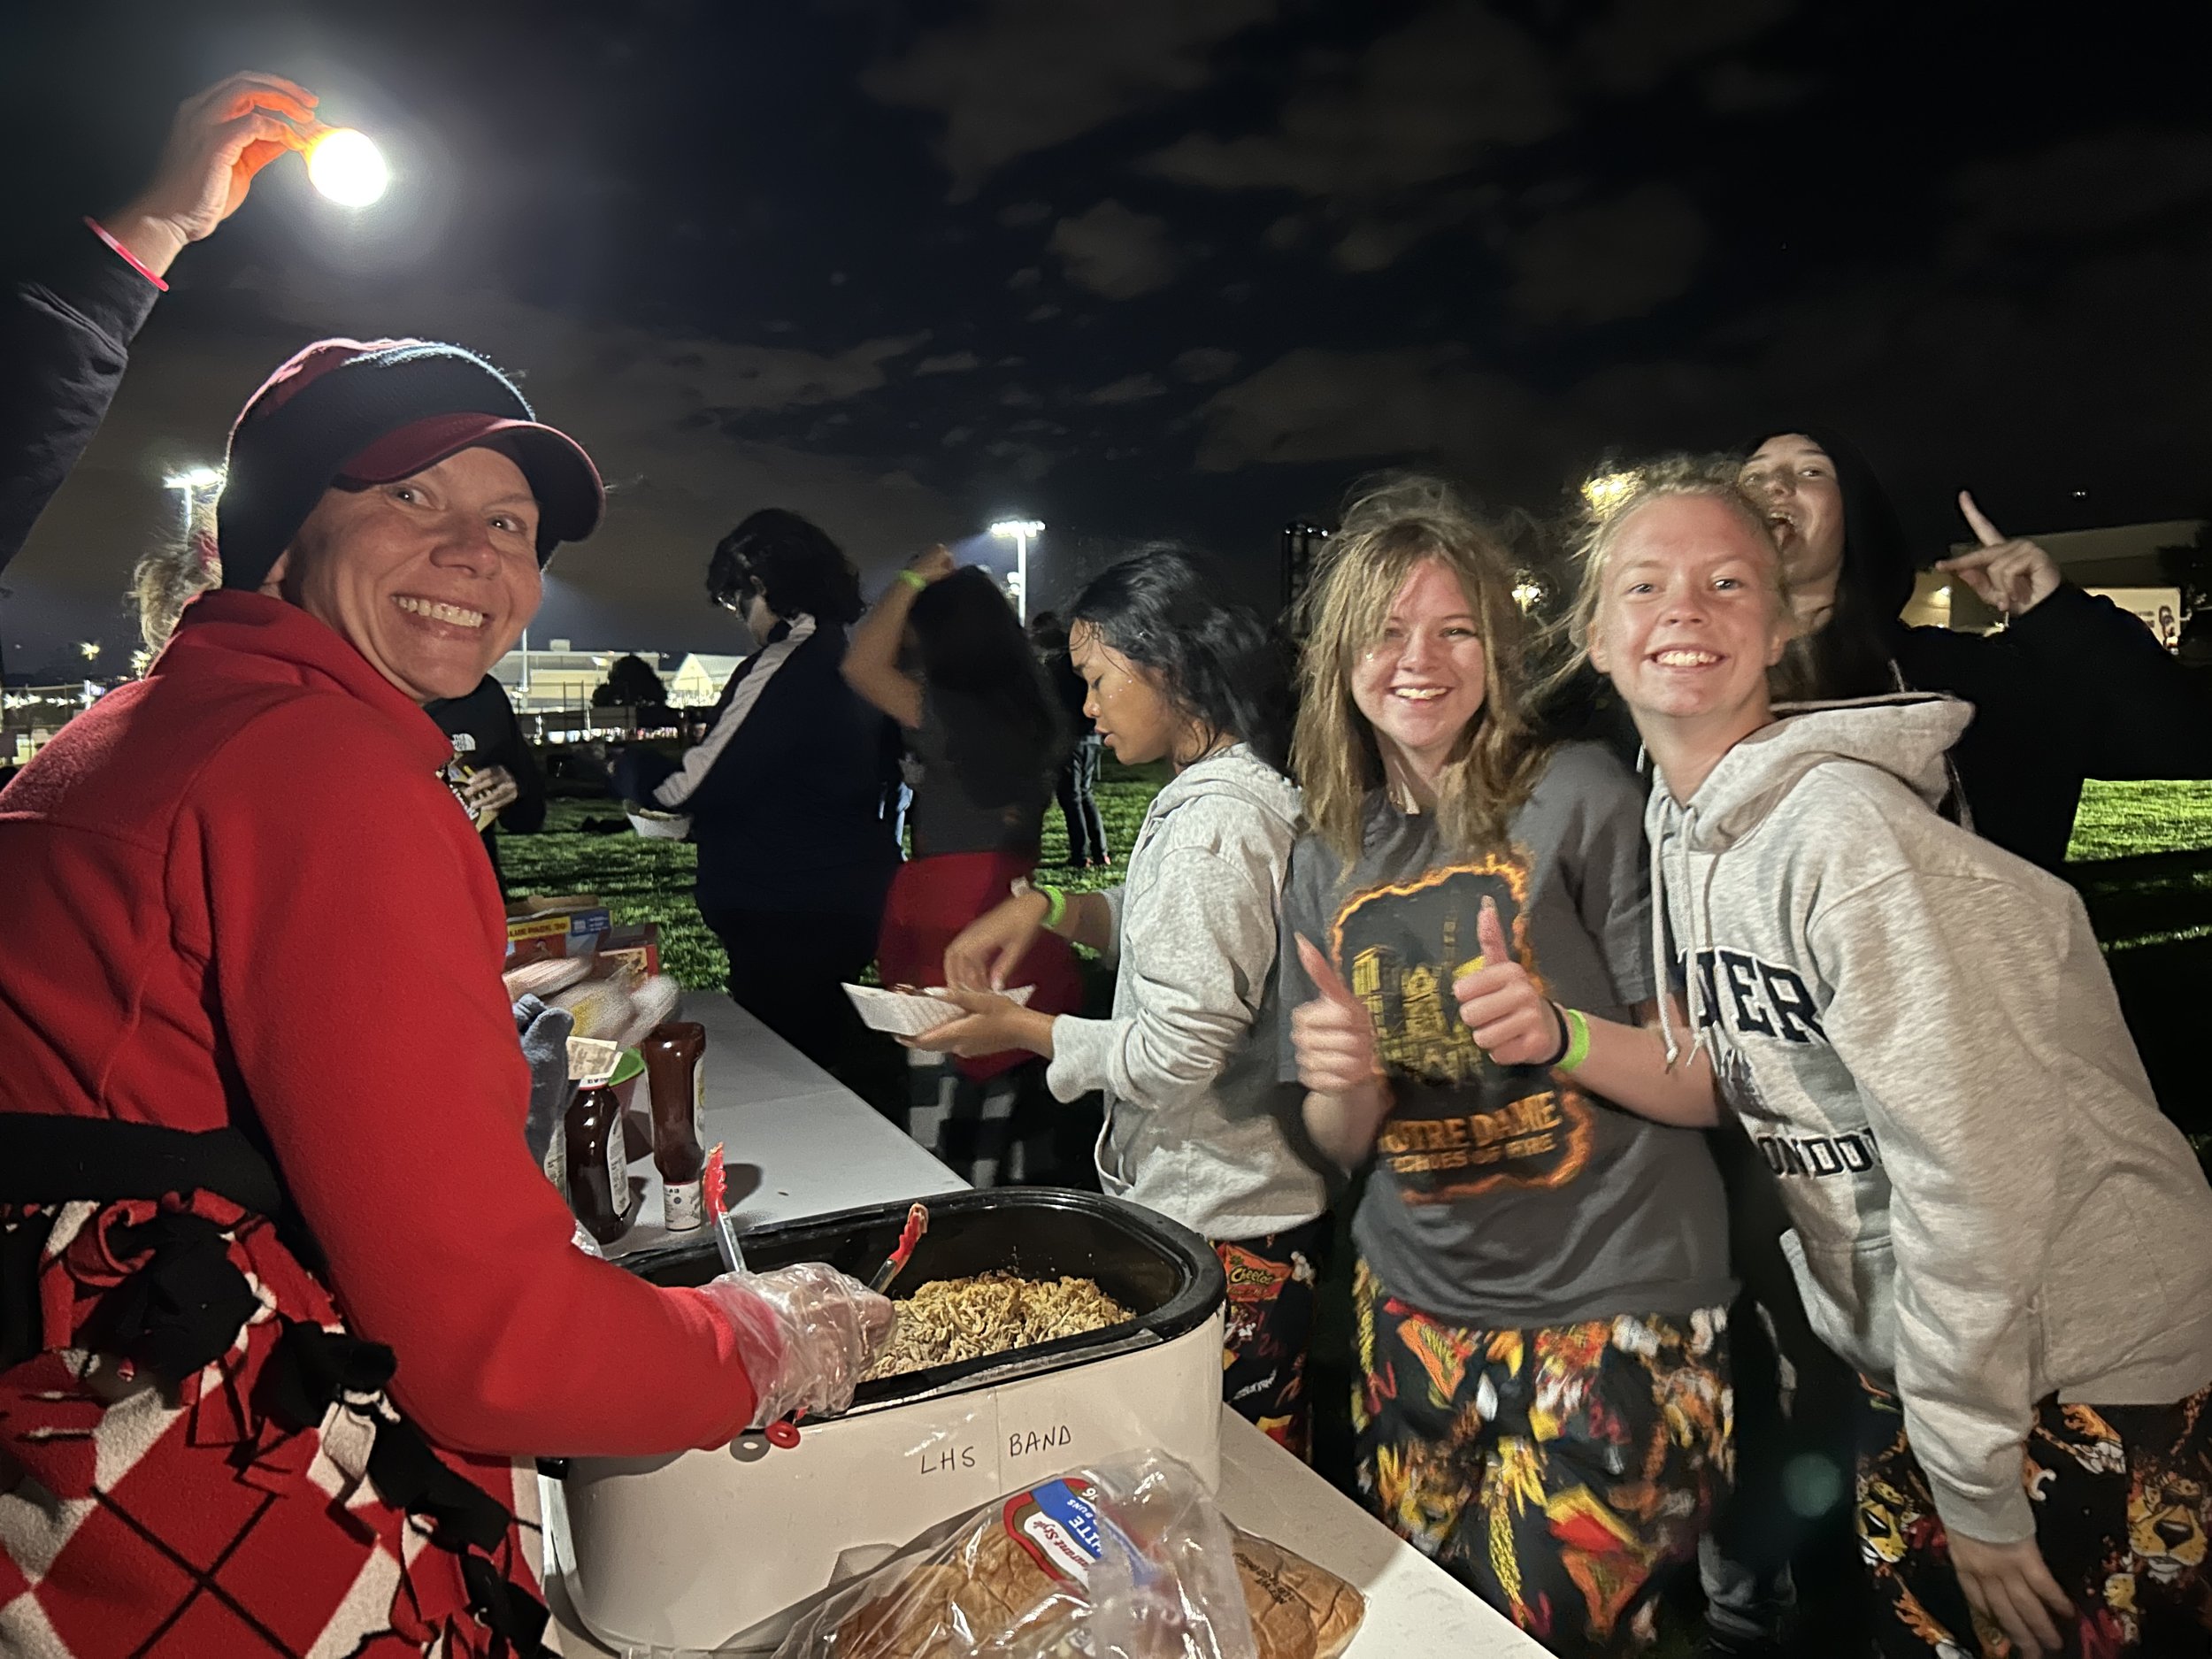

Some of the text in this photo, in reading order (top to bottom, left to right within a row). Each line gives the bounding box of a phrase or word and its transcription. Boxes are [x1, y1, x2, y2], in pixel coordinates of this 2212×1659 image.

[1756, 1127, 1883, 1178] ONDO
[1231, 1266, 1274, 1285] Cheetos
[921, 1425, 1071, 1475] LHS BAND
[1067, 1499, 1094, 1519] BUNS
[1033, 1520, 1089, 1571] aurant Style
[1068, 1515, 1102, 1555] HITE
